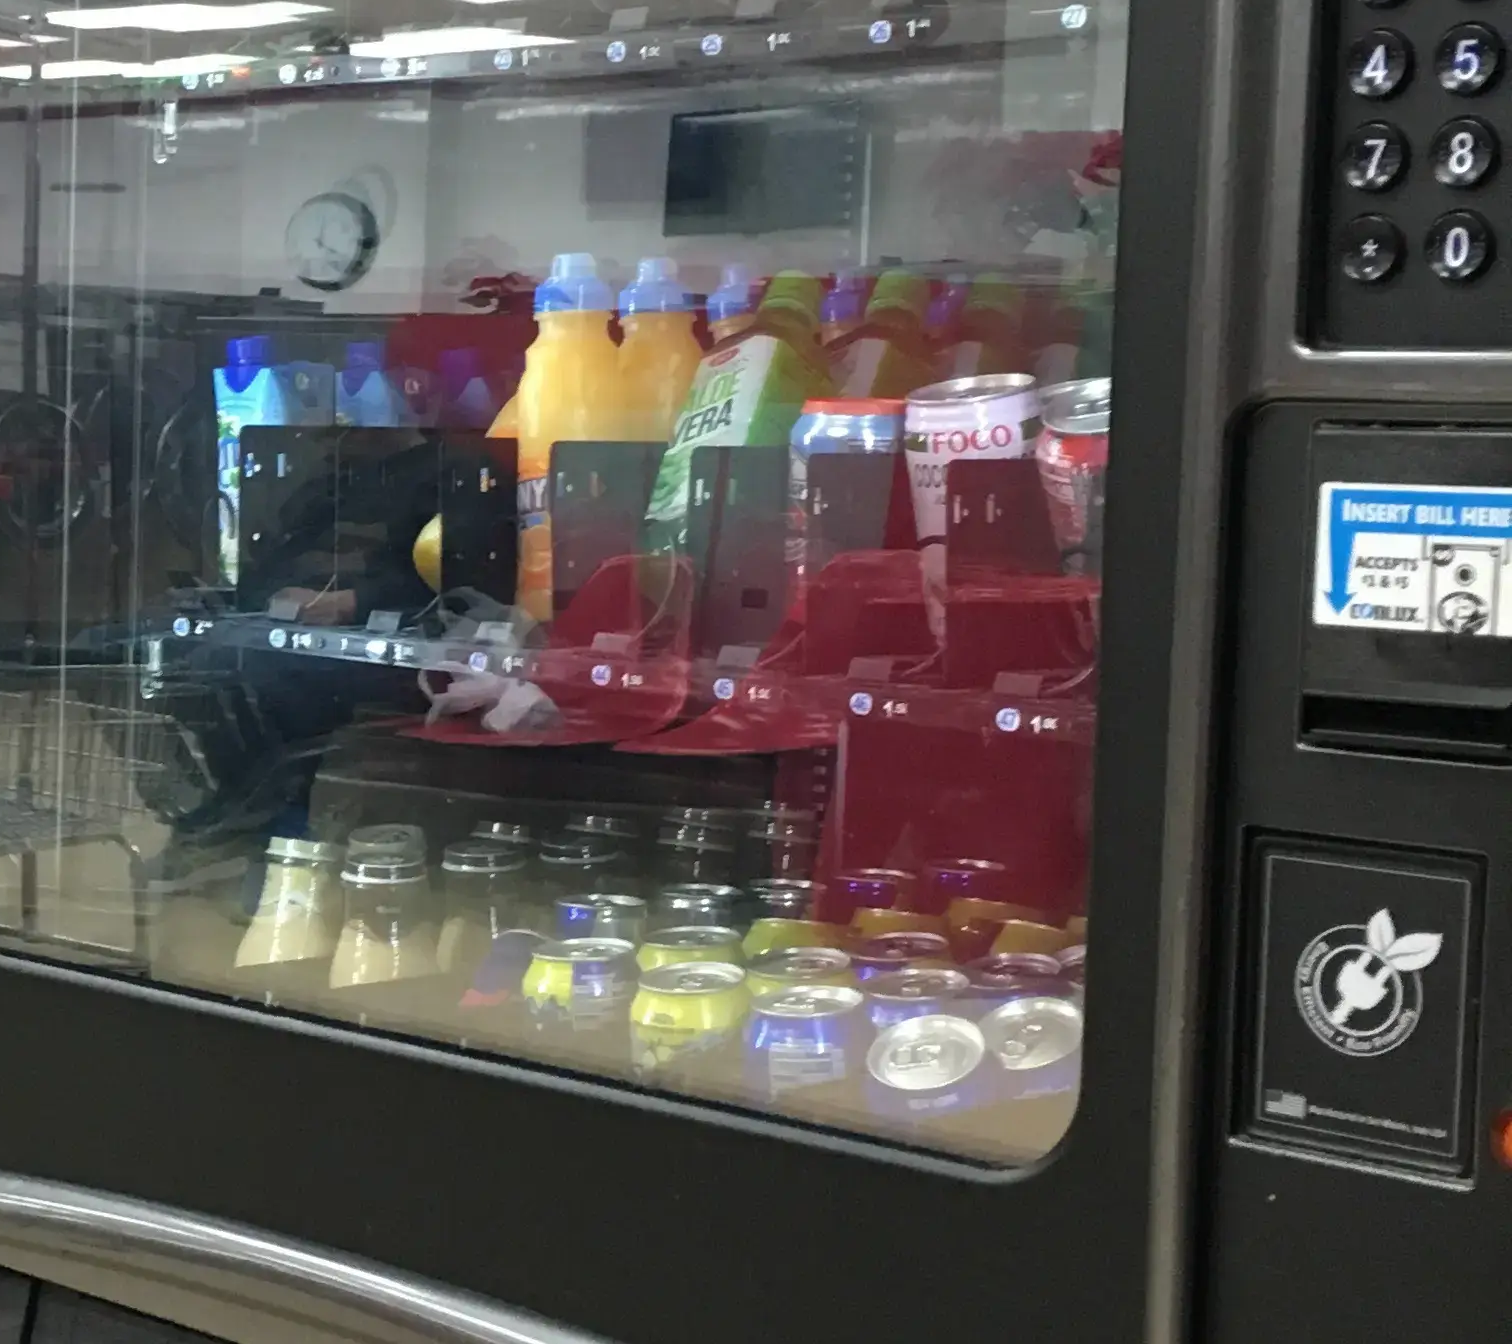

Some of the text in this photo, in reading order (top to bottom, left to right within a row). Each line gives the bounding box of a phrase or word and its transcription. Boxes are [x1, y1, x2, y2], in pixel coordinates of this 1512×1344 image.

[1363, 38, 1479, 86] 4 5
[1363, 131, 1474, 180] 7 8
[1444, 226, 1471, 268] 0
[674, 397, 734, 445] VERA
[932, 423, 1013, 455] FOCO
[1342, 498, 1512, 528] INSERT BILL HERE
[1354, 555, 1420, 572] ACCEPTS
